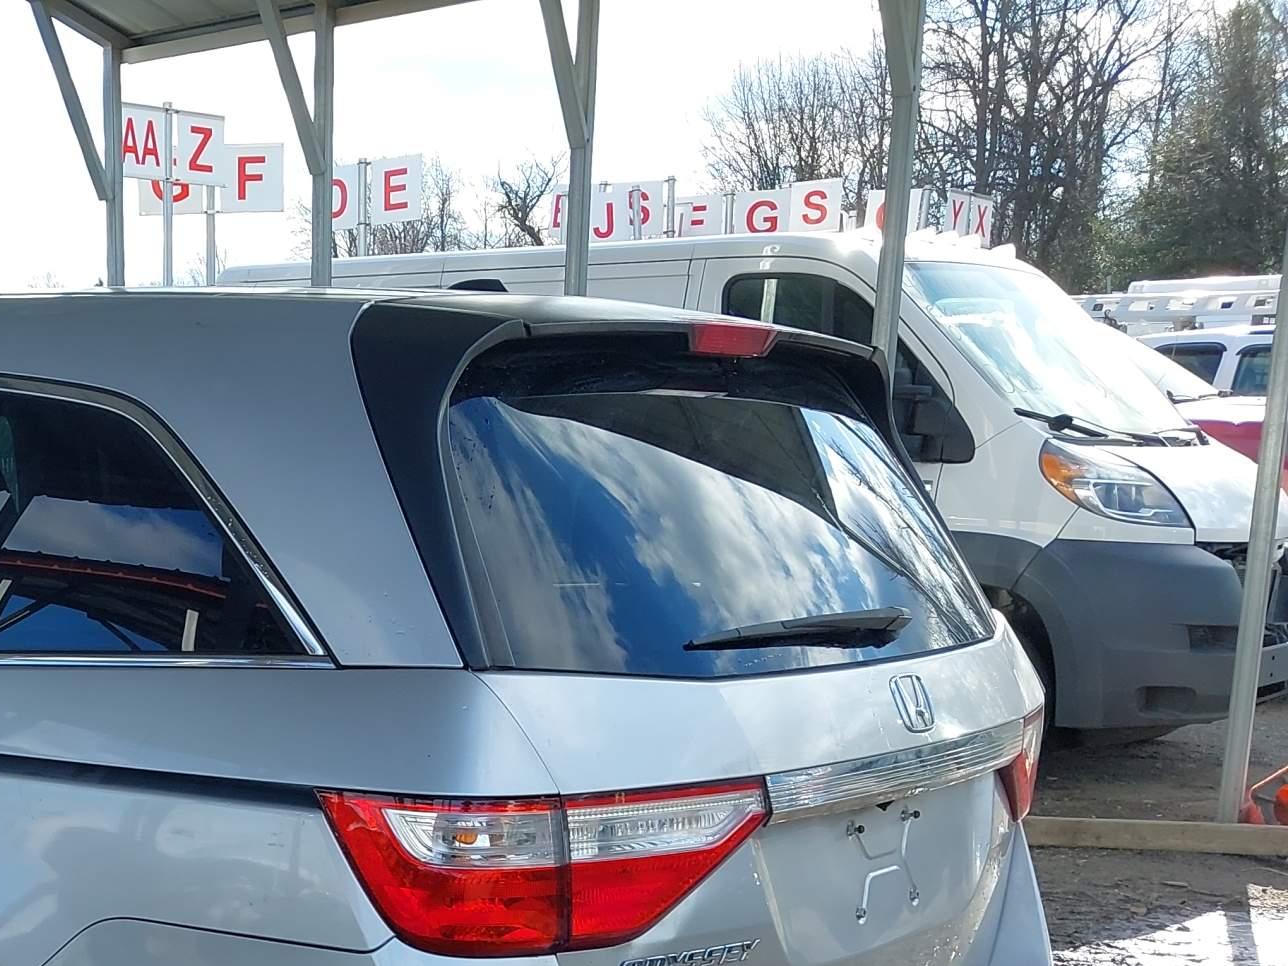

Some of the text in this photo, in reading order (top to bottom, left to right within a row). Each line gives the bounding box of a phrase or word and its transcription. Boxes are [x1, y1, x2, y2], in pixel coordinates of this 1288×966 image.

[122, 117, 160, 167] AA
[189, 126, 213, 173] Z
[238, 156, 266, 200] F
[384, 168, 408, 211] E
[593, 202, 614, 239] J
[746, 200, 779, 233] G
[802, 190, 828, 225] S
[975, 205, 987, 238] X
